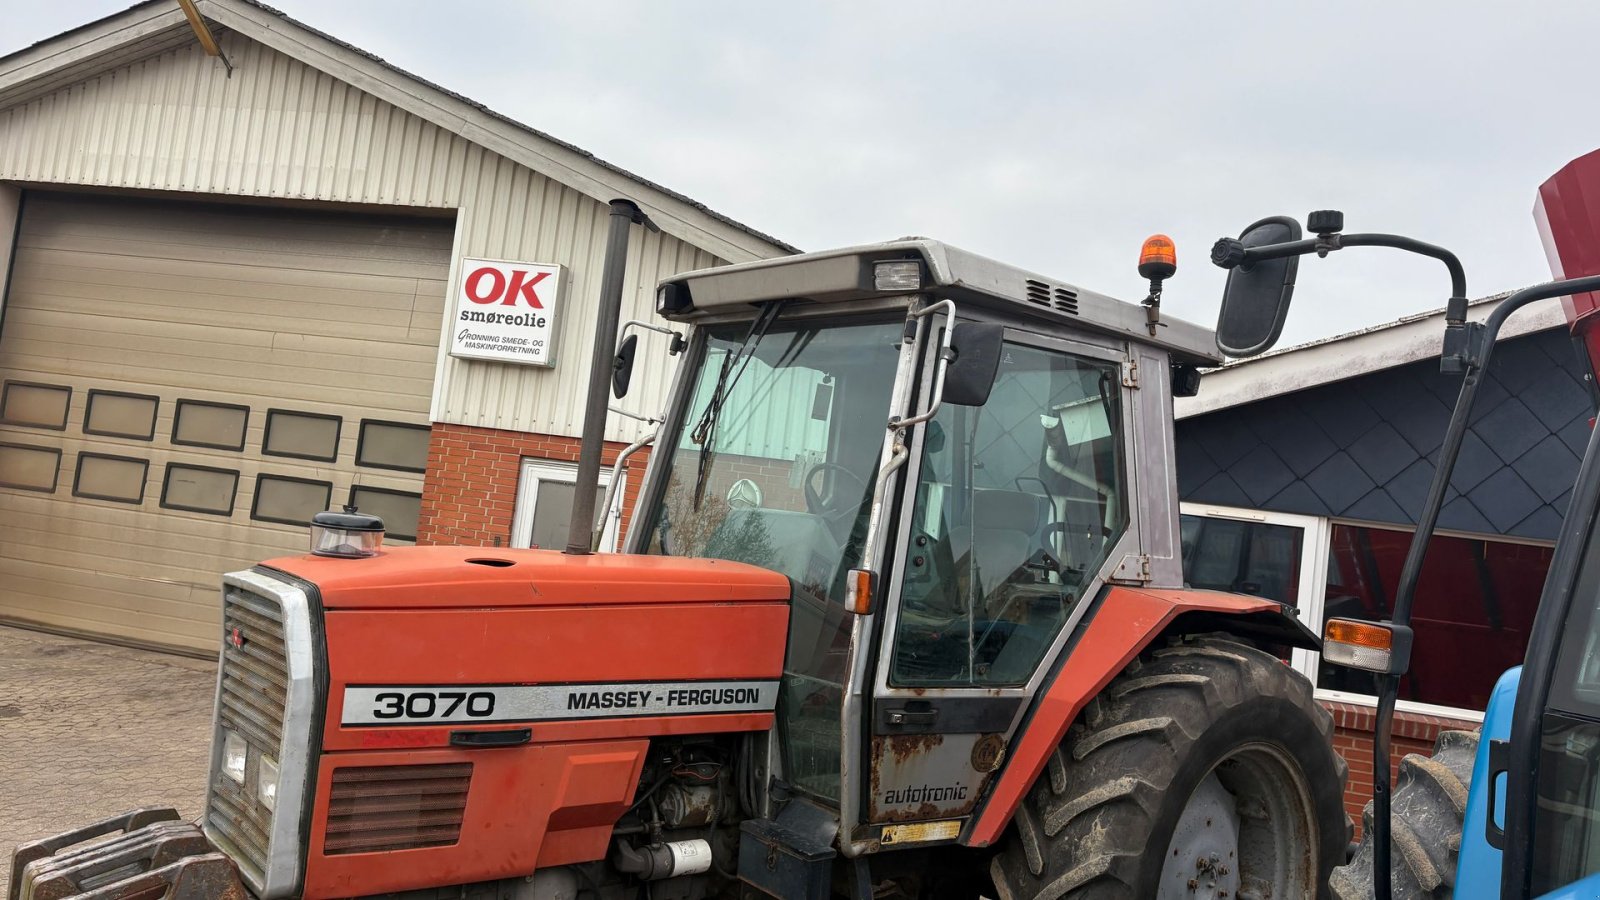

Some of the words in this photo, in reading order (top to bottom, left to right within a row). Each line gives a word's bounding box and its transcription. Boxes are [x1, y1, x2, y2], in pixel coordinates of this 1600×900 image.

[465, 267, 552, 309] OK
[460, 310, 546, 328] smøreolie
[464, 341, 540, 355] MASKINFORRETNING
[501, 336, 531, 346] SMEDE-
[532, 339, 544, 347] OG
[373, 692, 496, 718] 3070
[884, 782, 968, 804] autotronic
